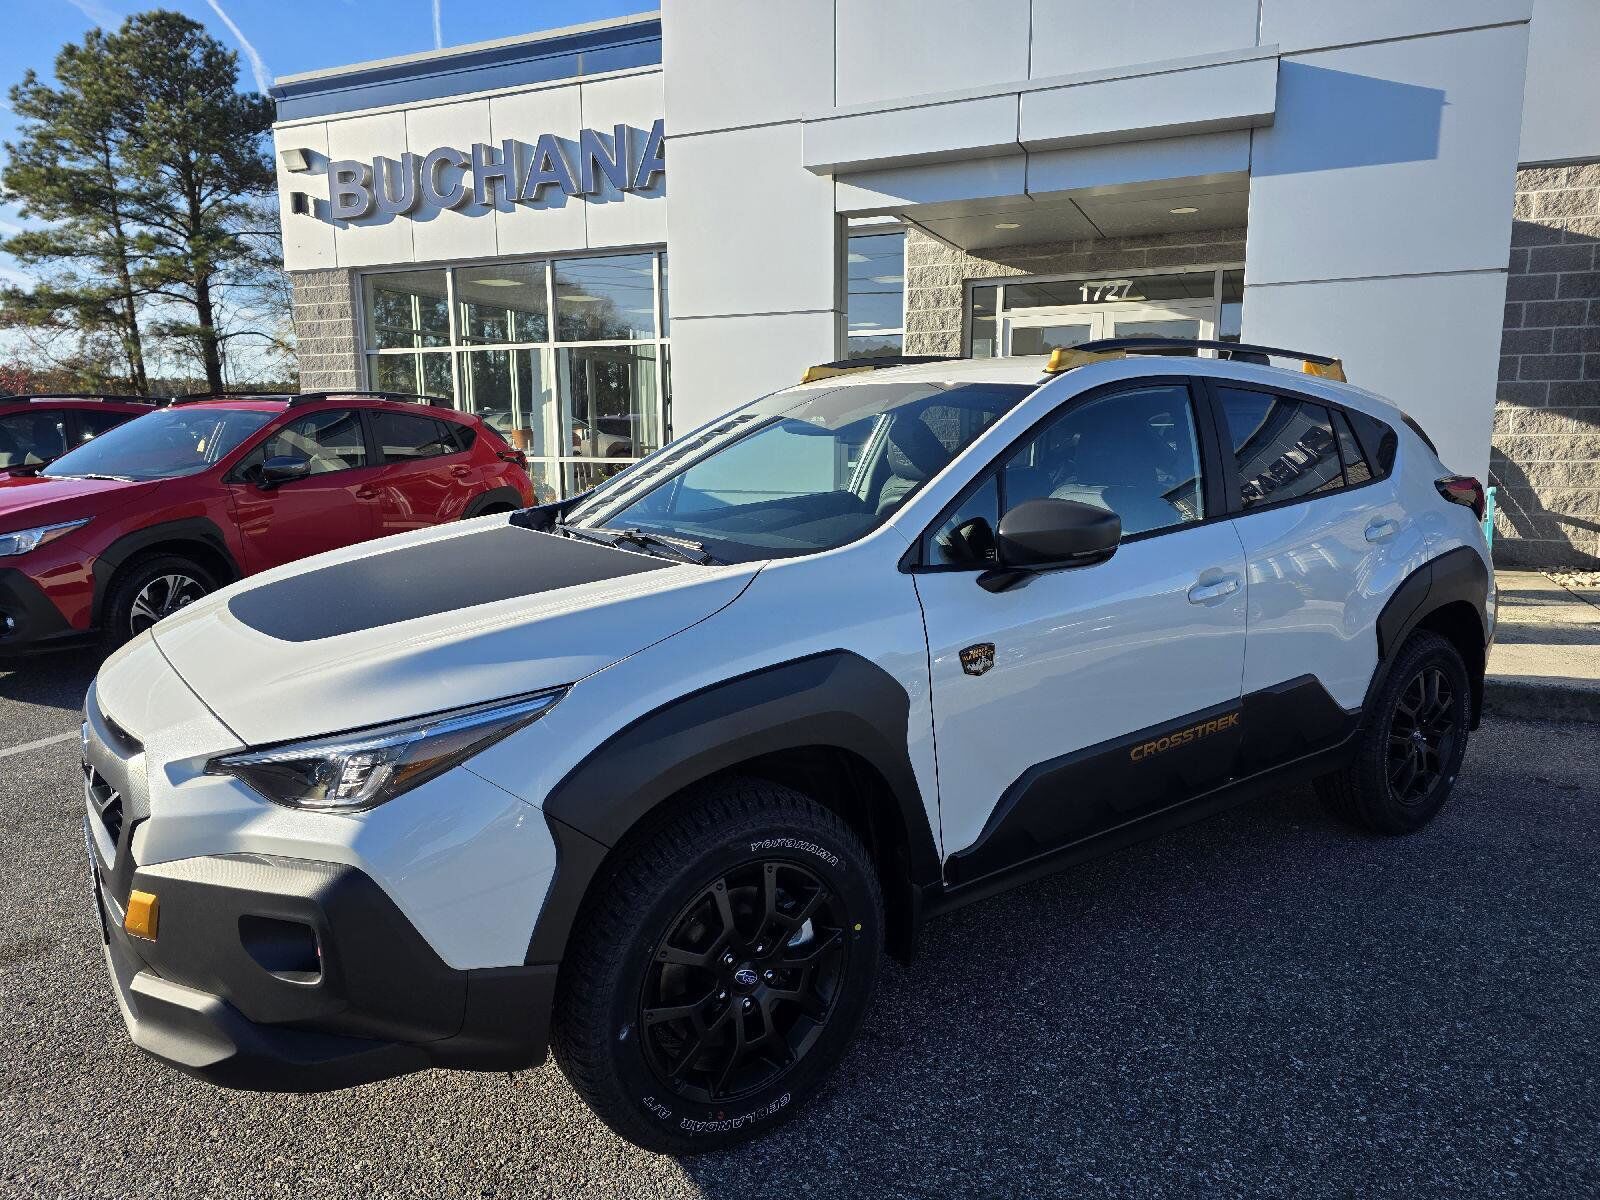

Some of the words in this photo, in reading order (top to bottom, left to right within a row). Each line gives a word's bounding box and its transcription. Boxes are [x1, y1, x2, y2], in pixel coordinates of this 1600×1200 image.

[1079, 280, 1134, 302] 1727
[1130, 713, 1240, 761] CROSSTREK
[750, 838, 839, 867] YOKOHAMA
[642, 1097, 672, 1120] A/T
[680, 1092, 791, 1132] GEOLANDAR
